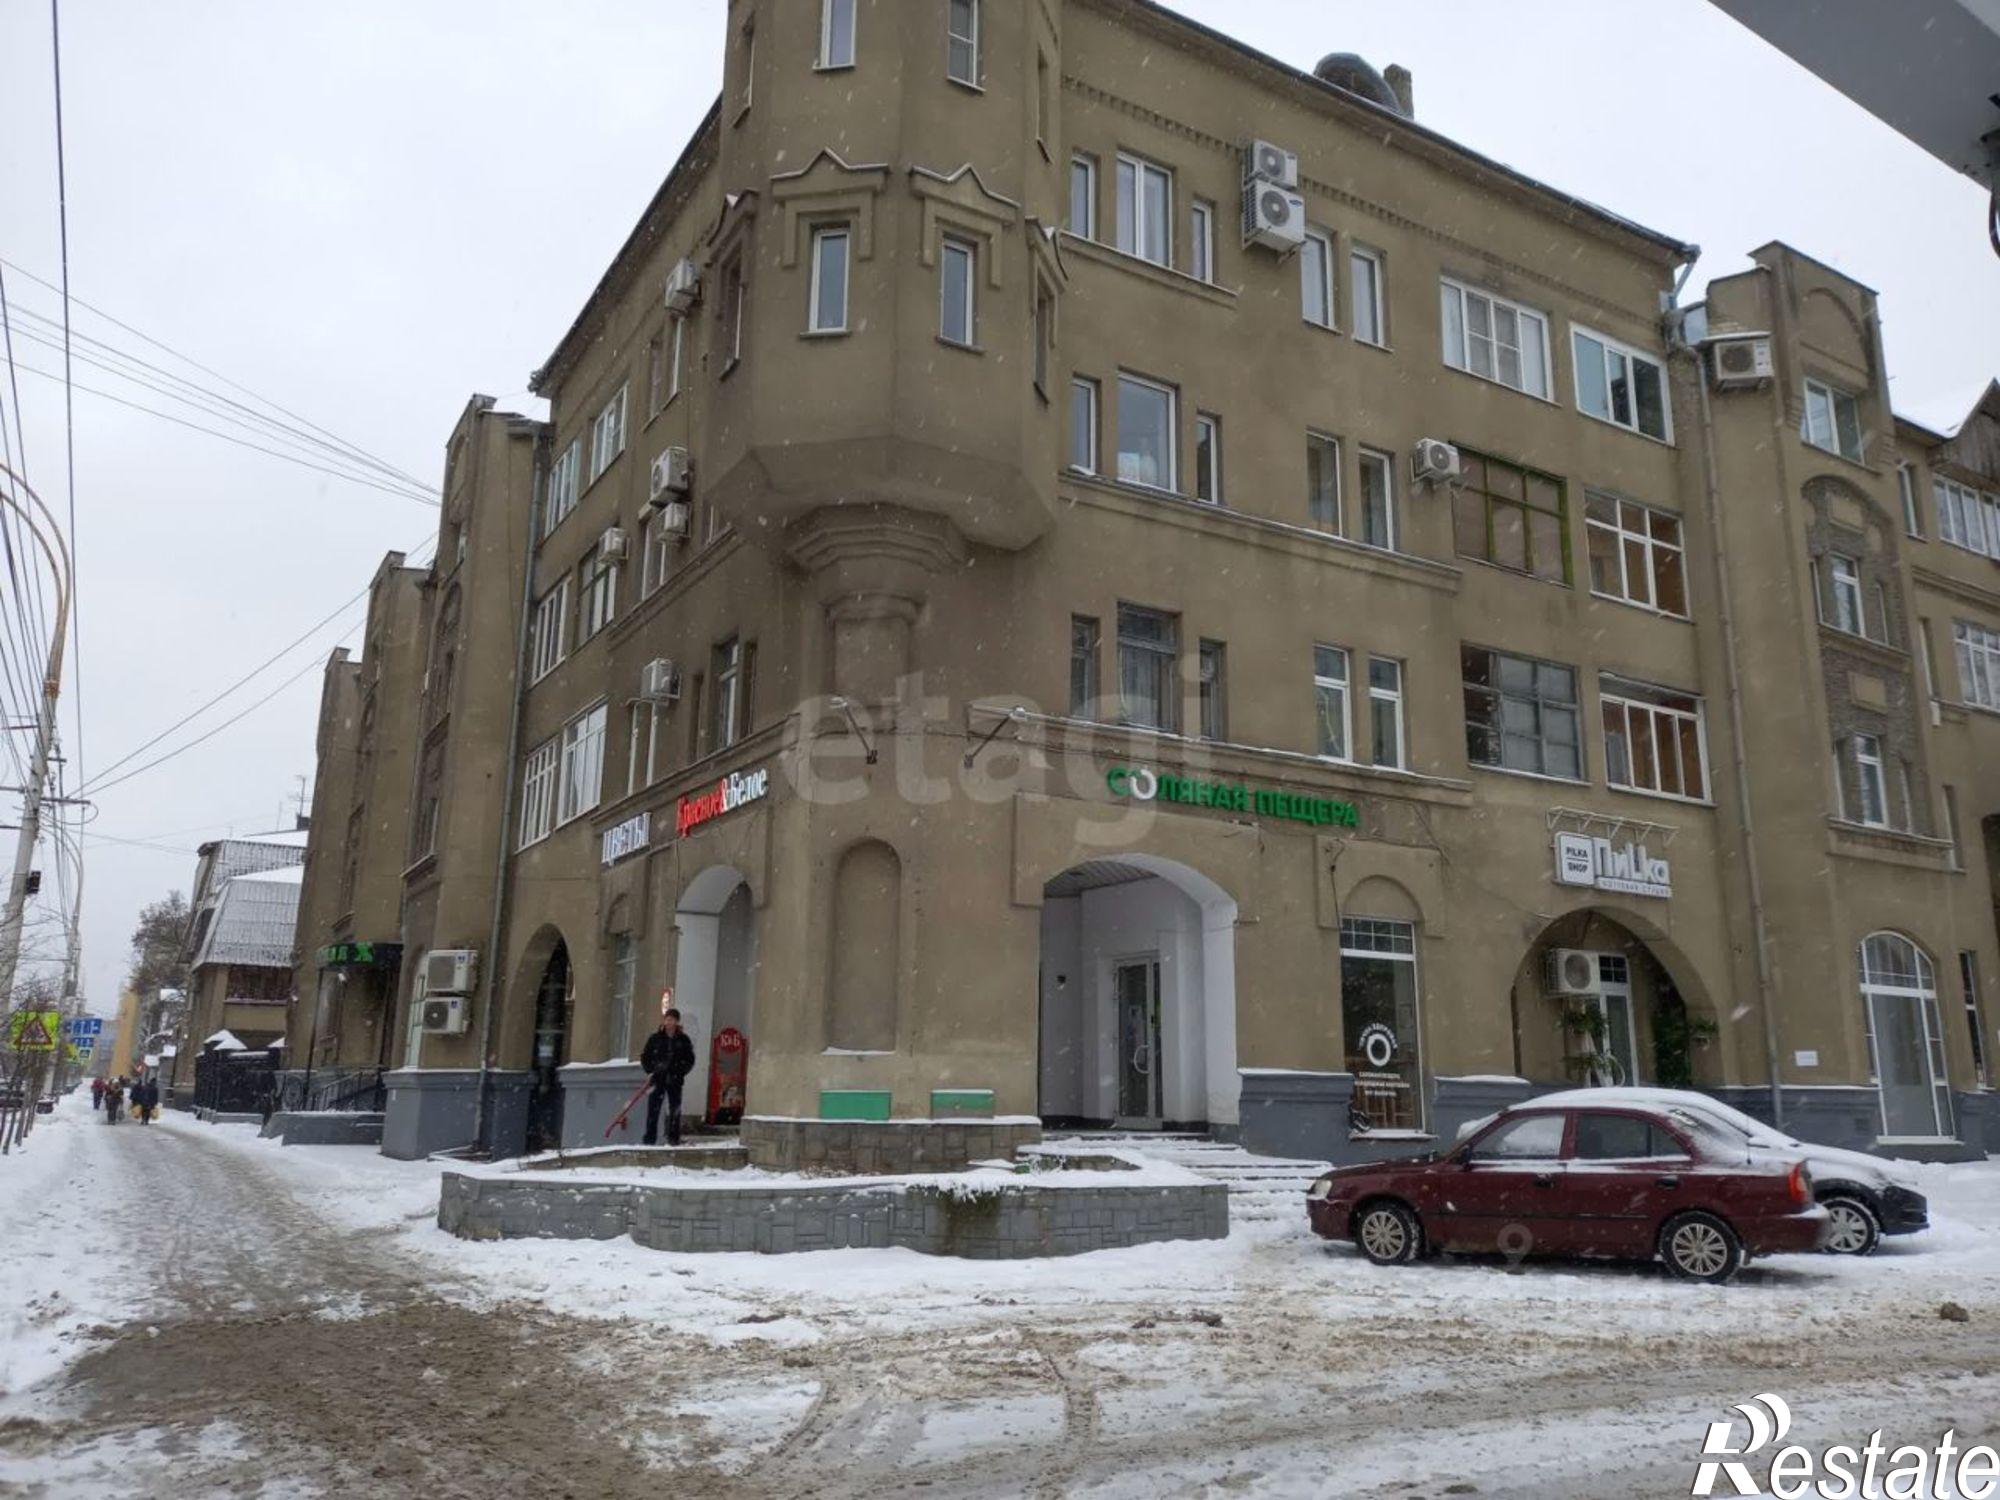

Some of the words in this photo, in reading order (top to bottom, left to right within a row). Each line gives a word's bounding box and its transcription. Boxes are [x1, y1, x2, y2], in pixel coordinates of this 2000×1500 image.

[1107, 767, 1249, 811] СОЛЯНАЯ
[1255, 789, 1361, 827] ПЕЩЕРА
[602, 812, 651, 866] ЦВЕТЫ
[1566, 847, 1588, 858] PILKA
[1568, 862, 1588, 873] SHOP
